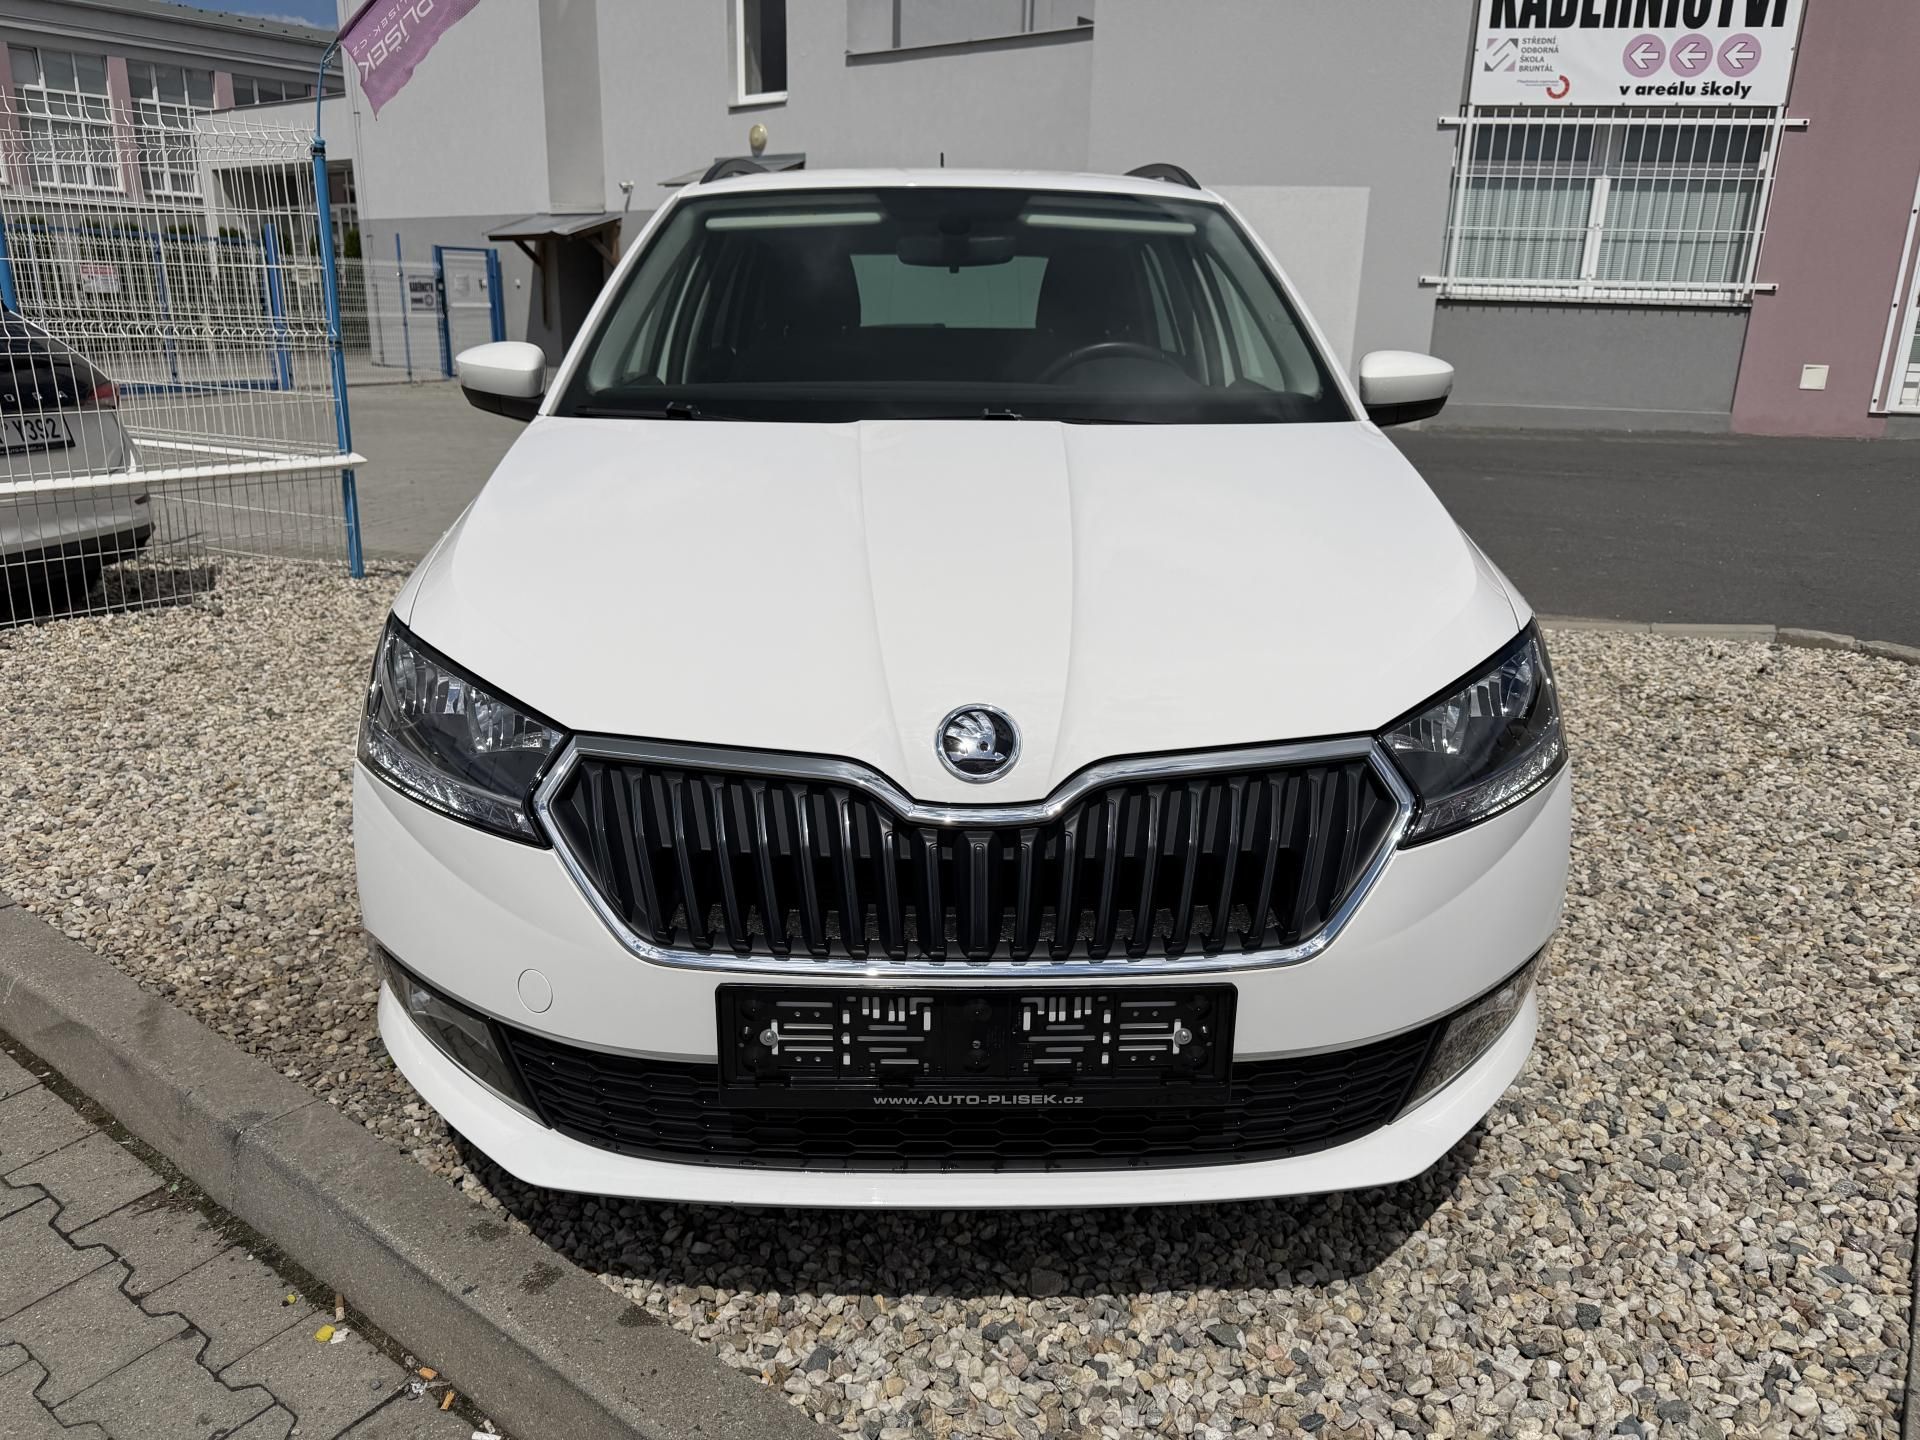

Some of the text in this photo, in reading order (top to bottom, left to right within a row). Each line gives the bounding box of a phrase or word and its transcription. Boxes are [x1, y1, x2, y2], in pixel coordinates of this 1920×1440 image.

[1521, 35, 1557, 45] STŘEDNÍ
[1520, 45, 1559, 54] ODBORNÁ
[1519, 54, 1545, 63] ŠKOLA
[1518, 64, 1554, 72] BRUNTÁL
[1619, 80, 1752, 100] v areálu školy
[873, 1094, 1084, 1105] www.AUTO-PLISEK.cz
